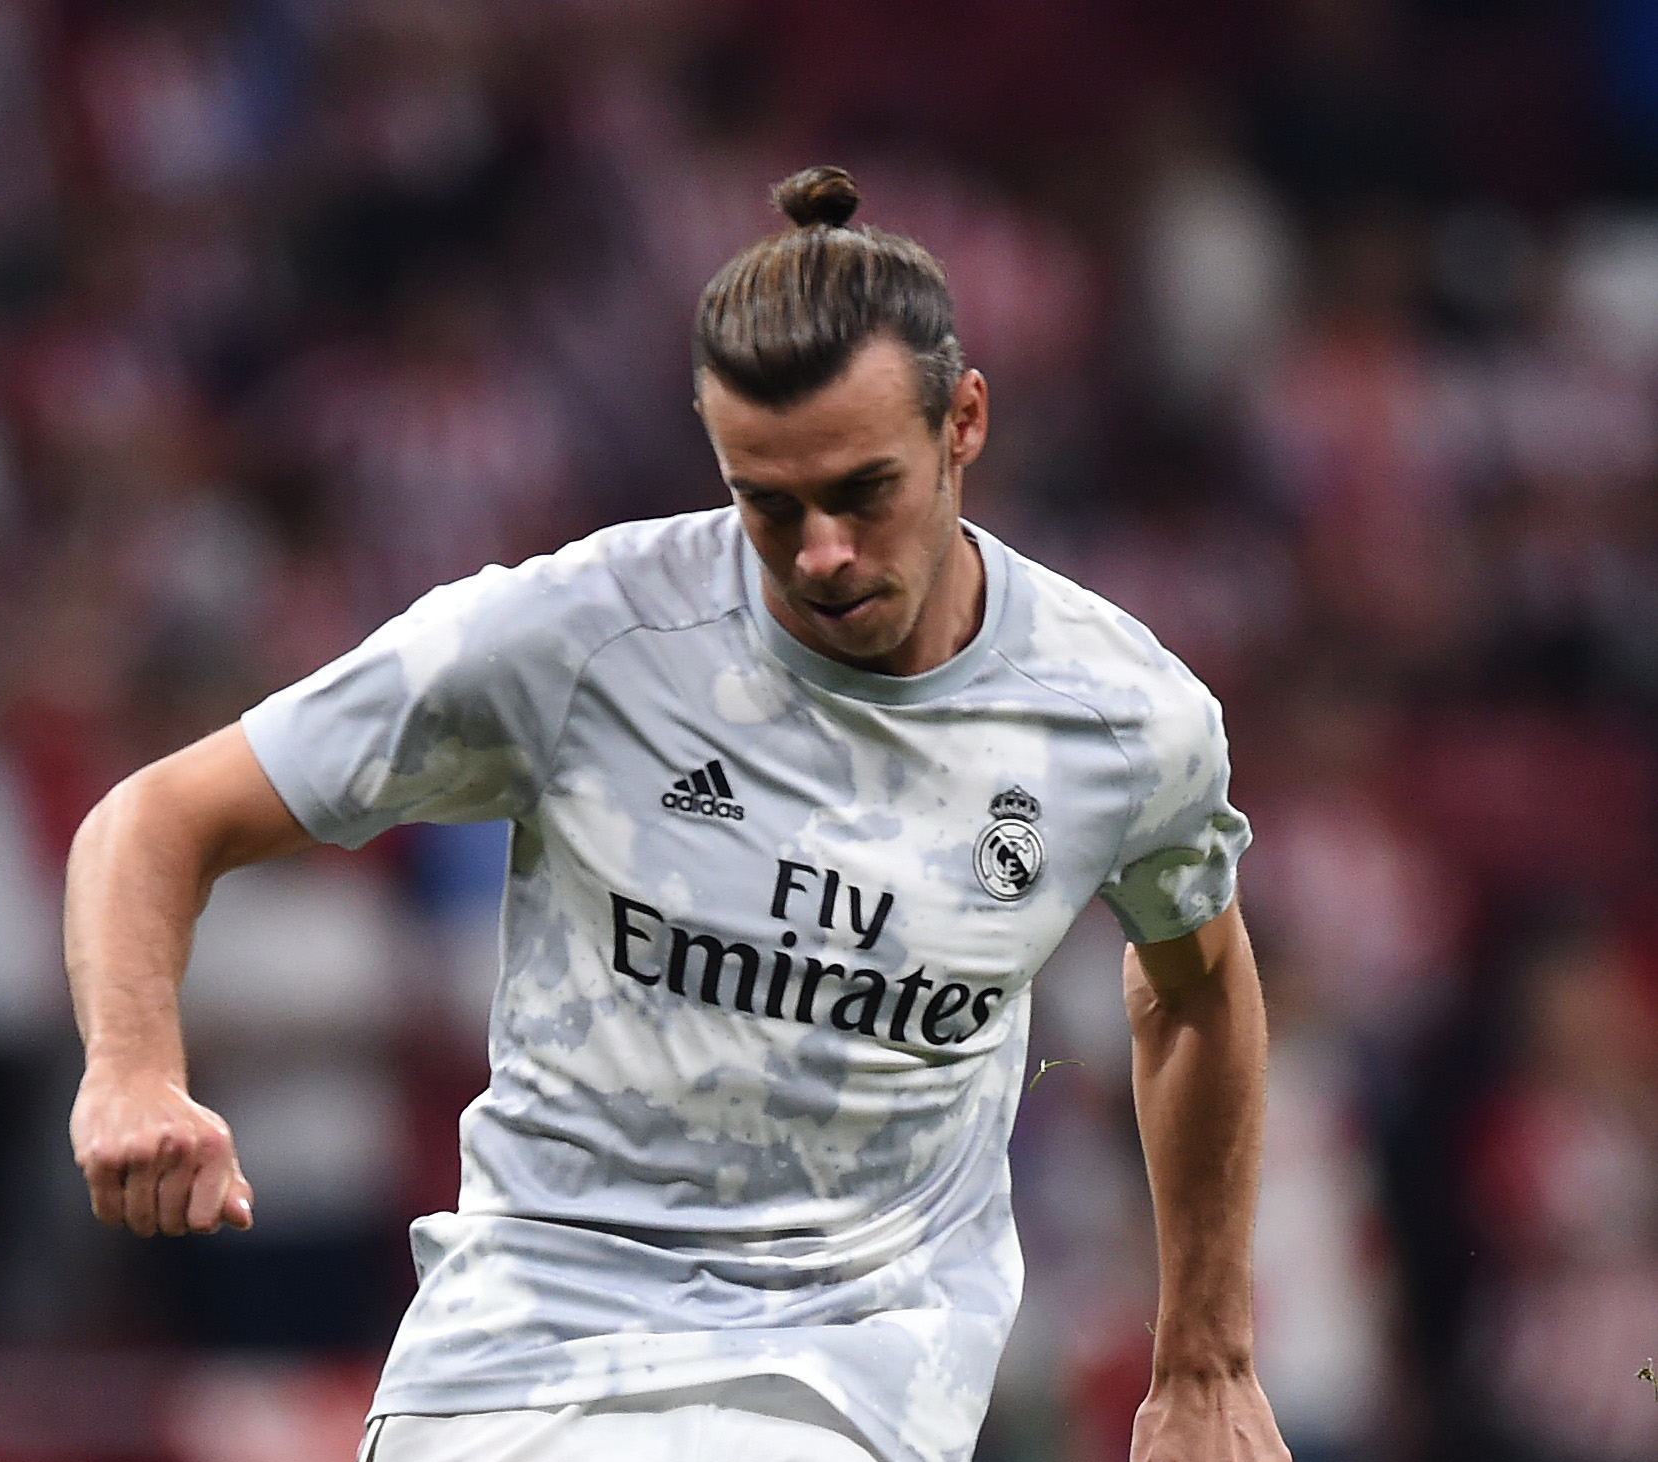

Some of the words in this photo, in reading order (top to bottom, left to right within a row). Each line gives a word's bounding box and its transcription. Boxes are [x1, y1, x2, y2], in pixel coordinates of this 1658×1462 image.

[662, 791, 744, 821] adidas
[771, 859, 895, 949] Fly
[609, 892, 1003, 1046] Emirates
